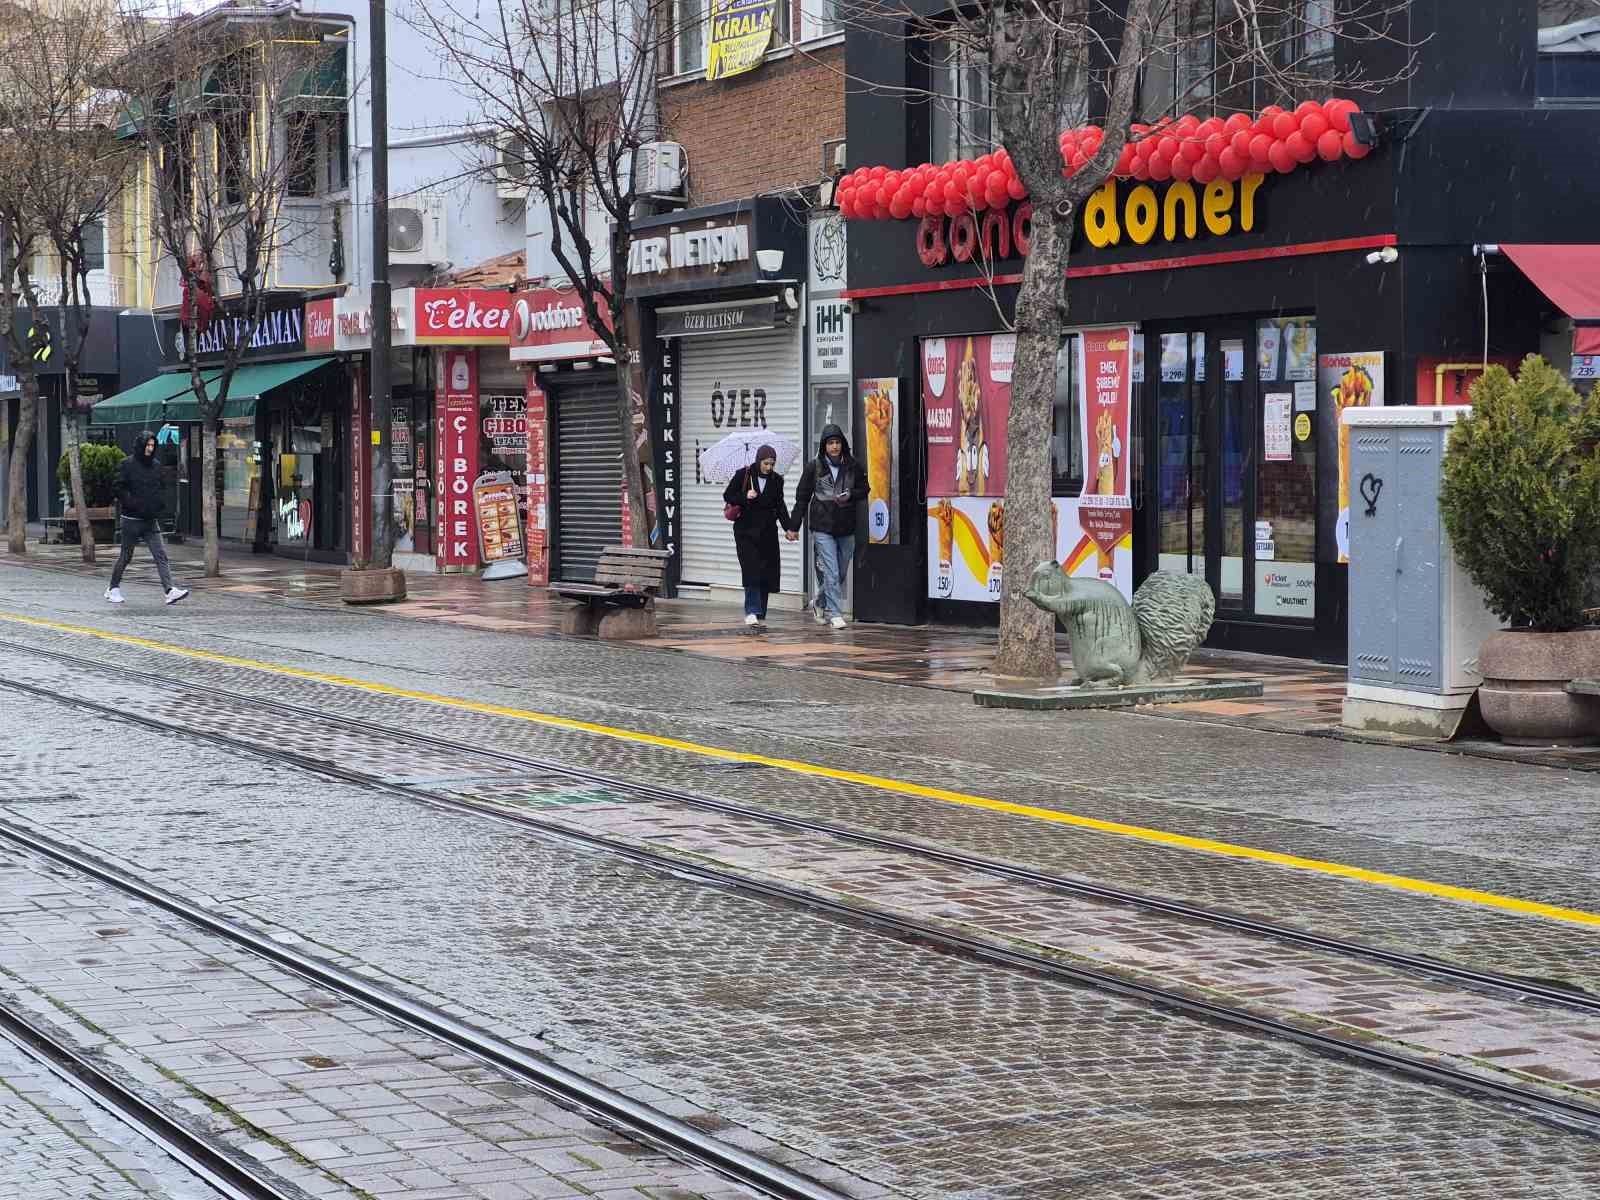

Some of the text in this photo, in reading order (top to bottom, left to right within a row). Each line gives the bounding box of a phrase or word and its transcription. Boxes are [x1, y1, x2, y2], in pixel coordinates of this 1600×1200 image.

[193, 308, 301, 352] ASAN RAMAN
[531, 302, 582, 331] vodafone
[711, 376, 767, 429] ÖZER
